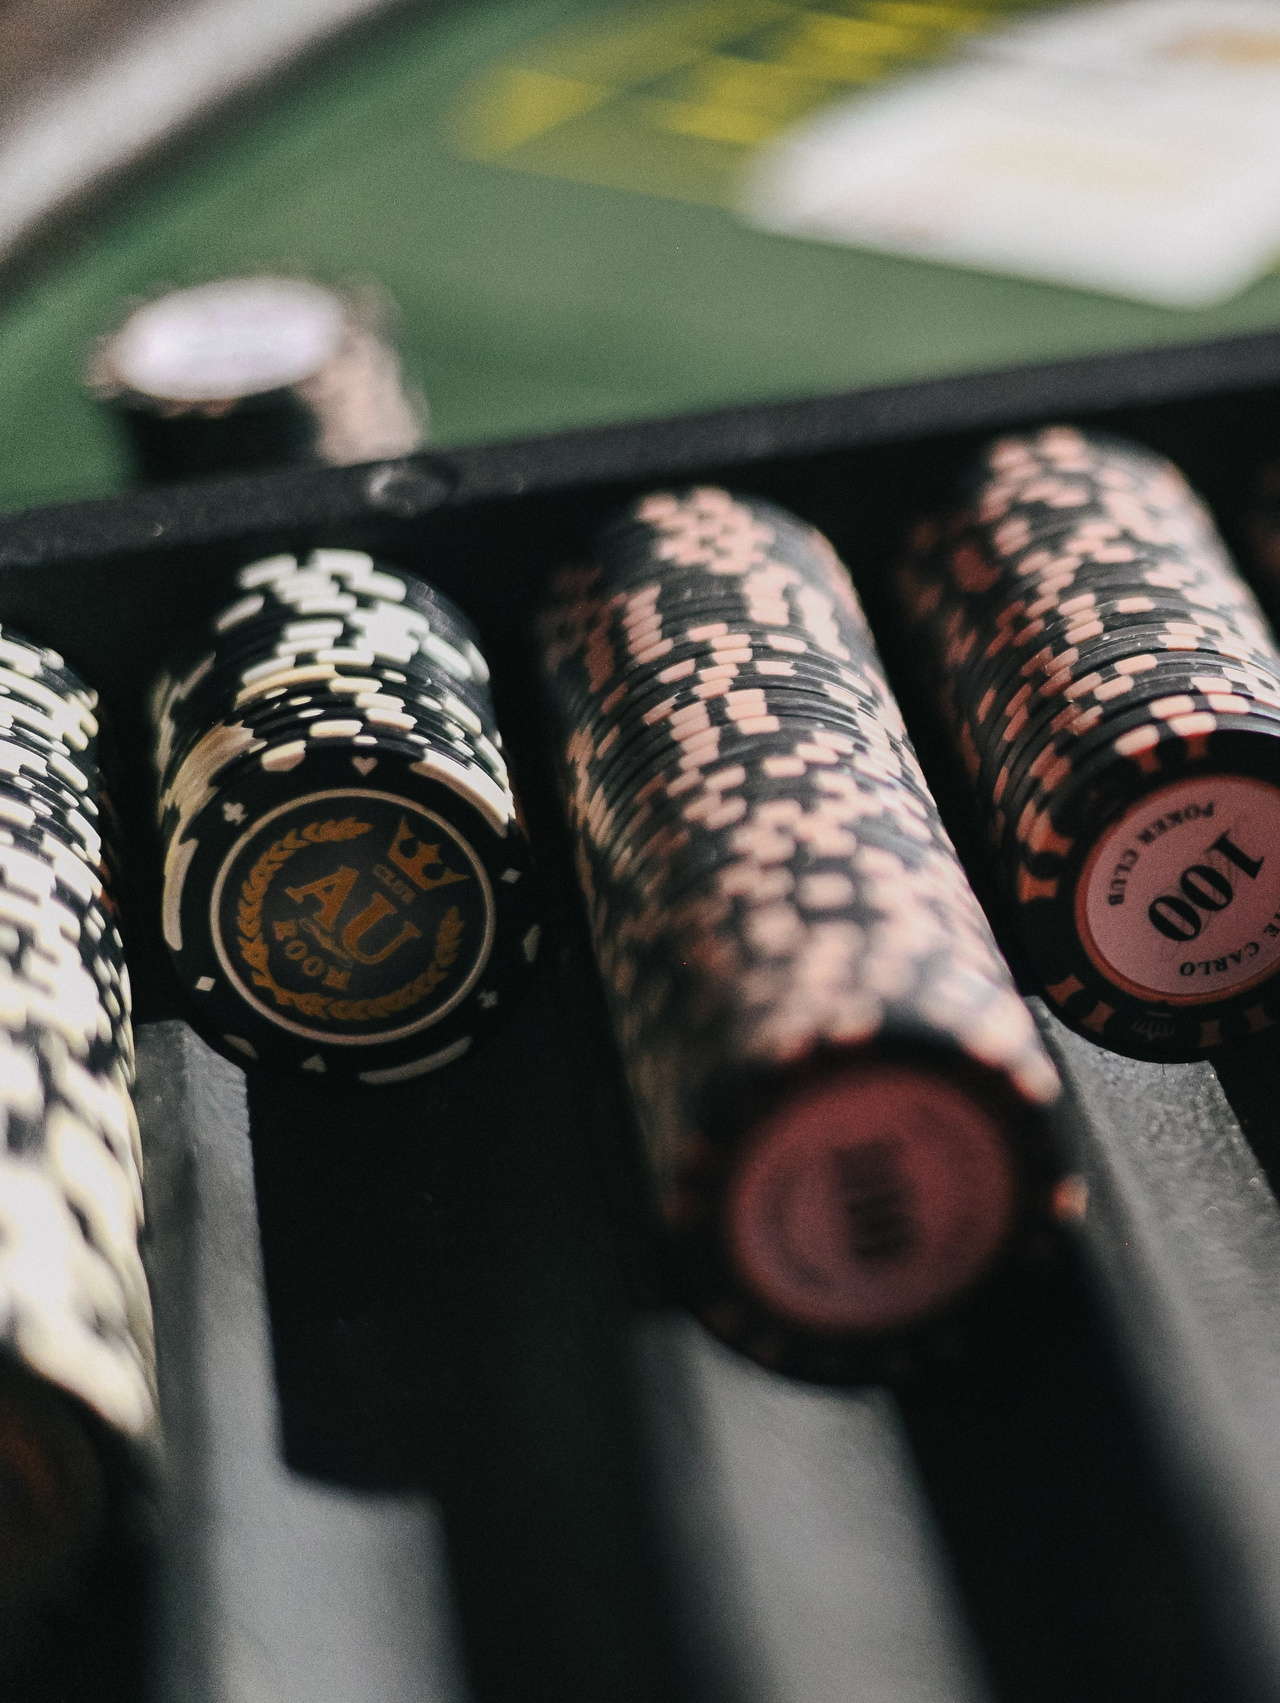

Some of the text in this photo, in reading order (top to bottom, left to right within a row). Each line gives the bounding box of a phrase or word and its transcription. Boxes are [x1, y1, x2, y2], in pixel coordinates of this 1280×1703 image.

[284, 865, 422, 965] AU
[1106, 849, 1139, 906] CLUB
[1148, 828, 1265, 942] 100
[1180, 941, 1260, 976] CARLO
